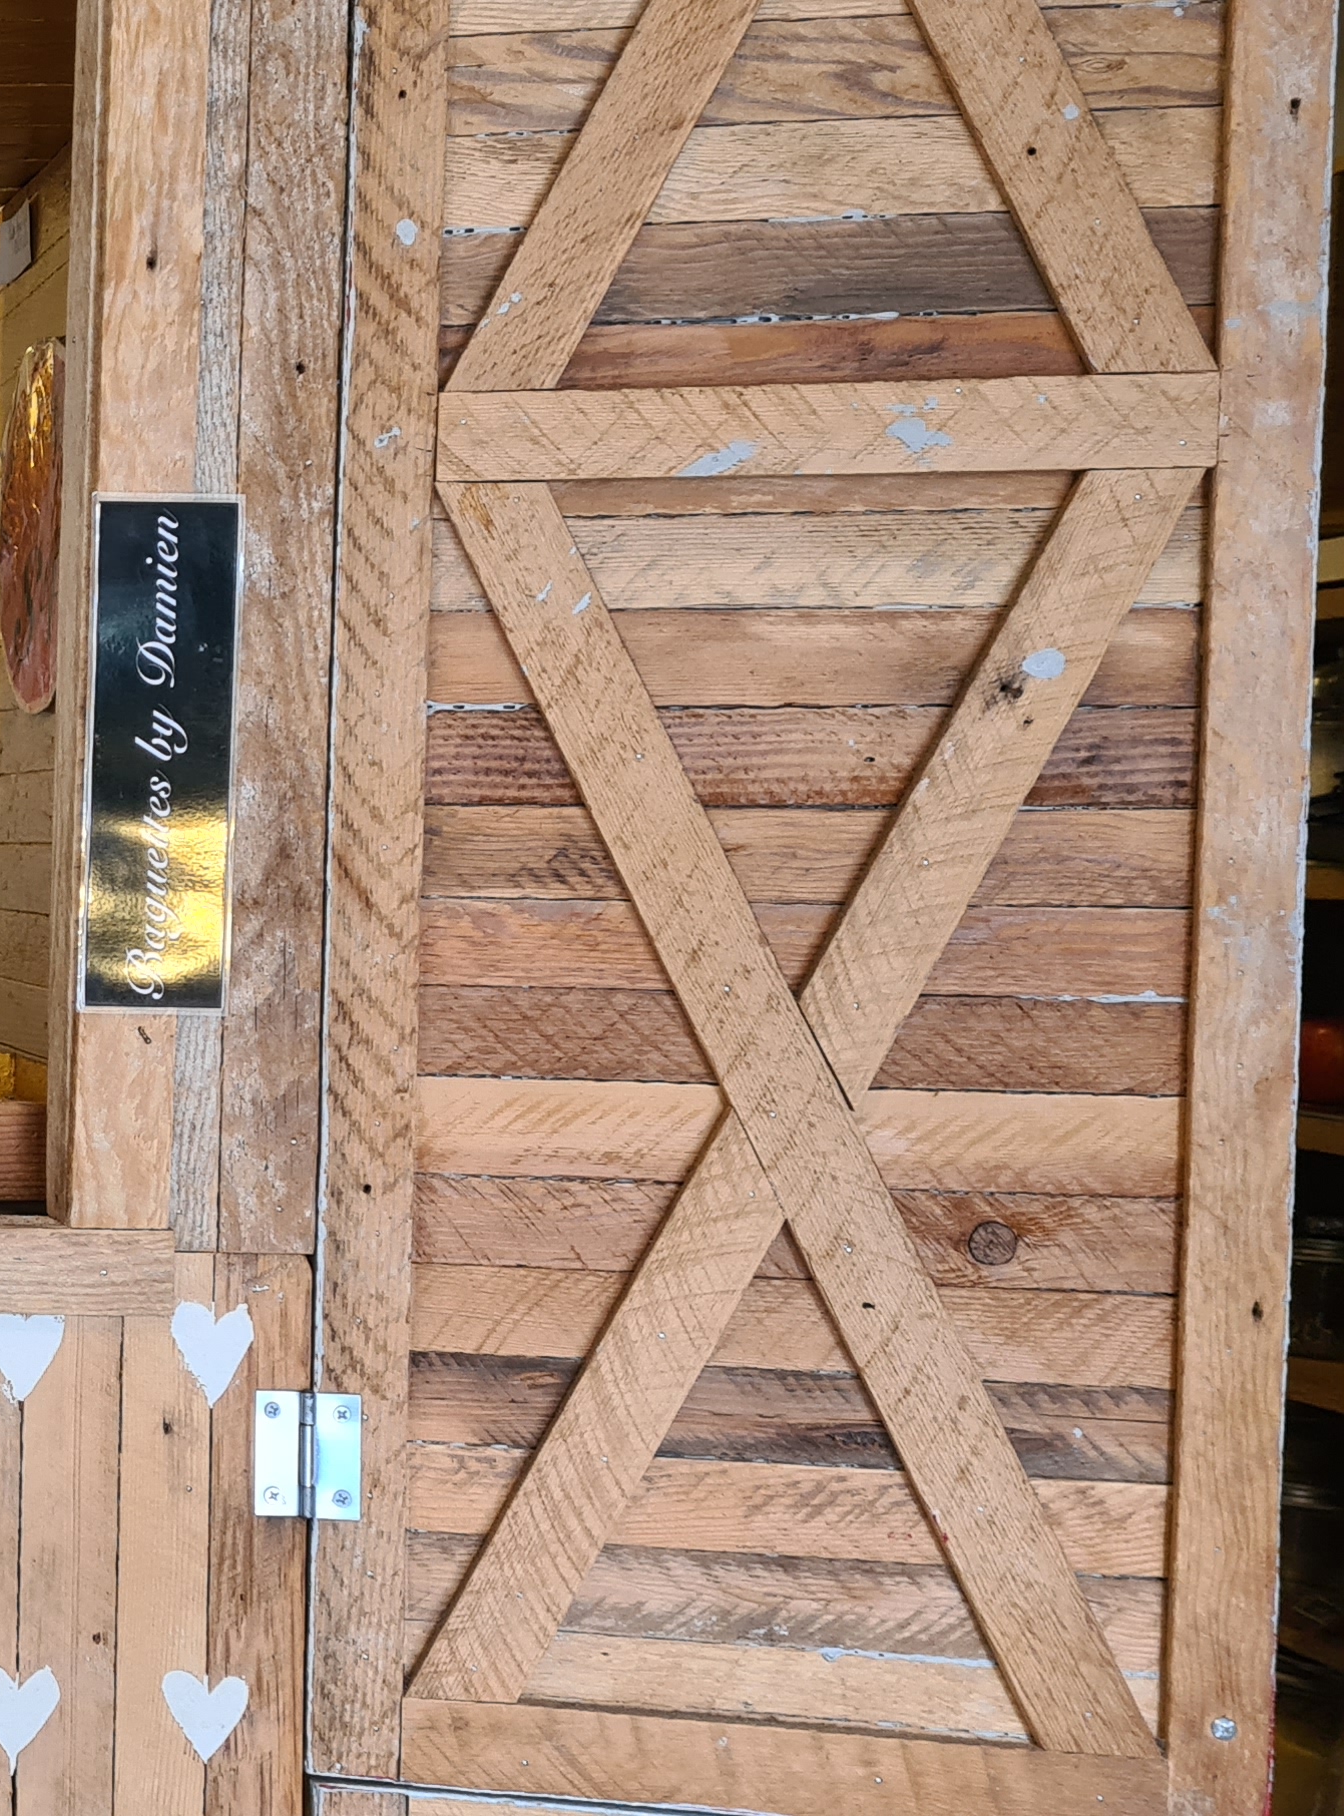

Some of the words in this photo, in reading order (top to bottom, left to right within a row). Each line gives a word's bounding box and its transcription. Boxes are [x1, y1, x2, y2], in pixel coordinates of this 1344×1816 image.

[135, 506, 181, 689] Damien
[135, 703, 189, 762] by
[126, 768, 182, 1001] Baguettes
